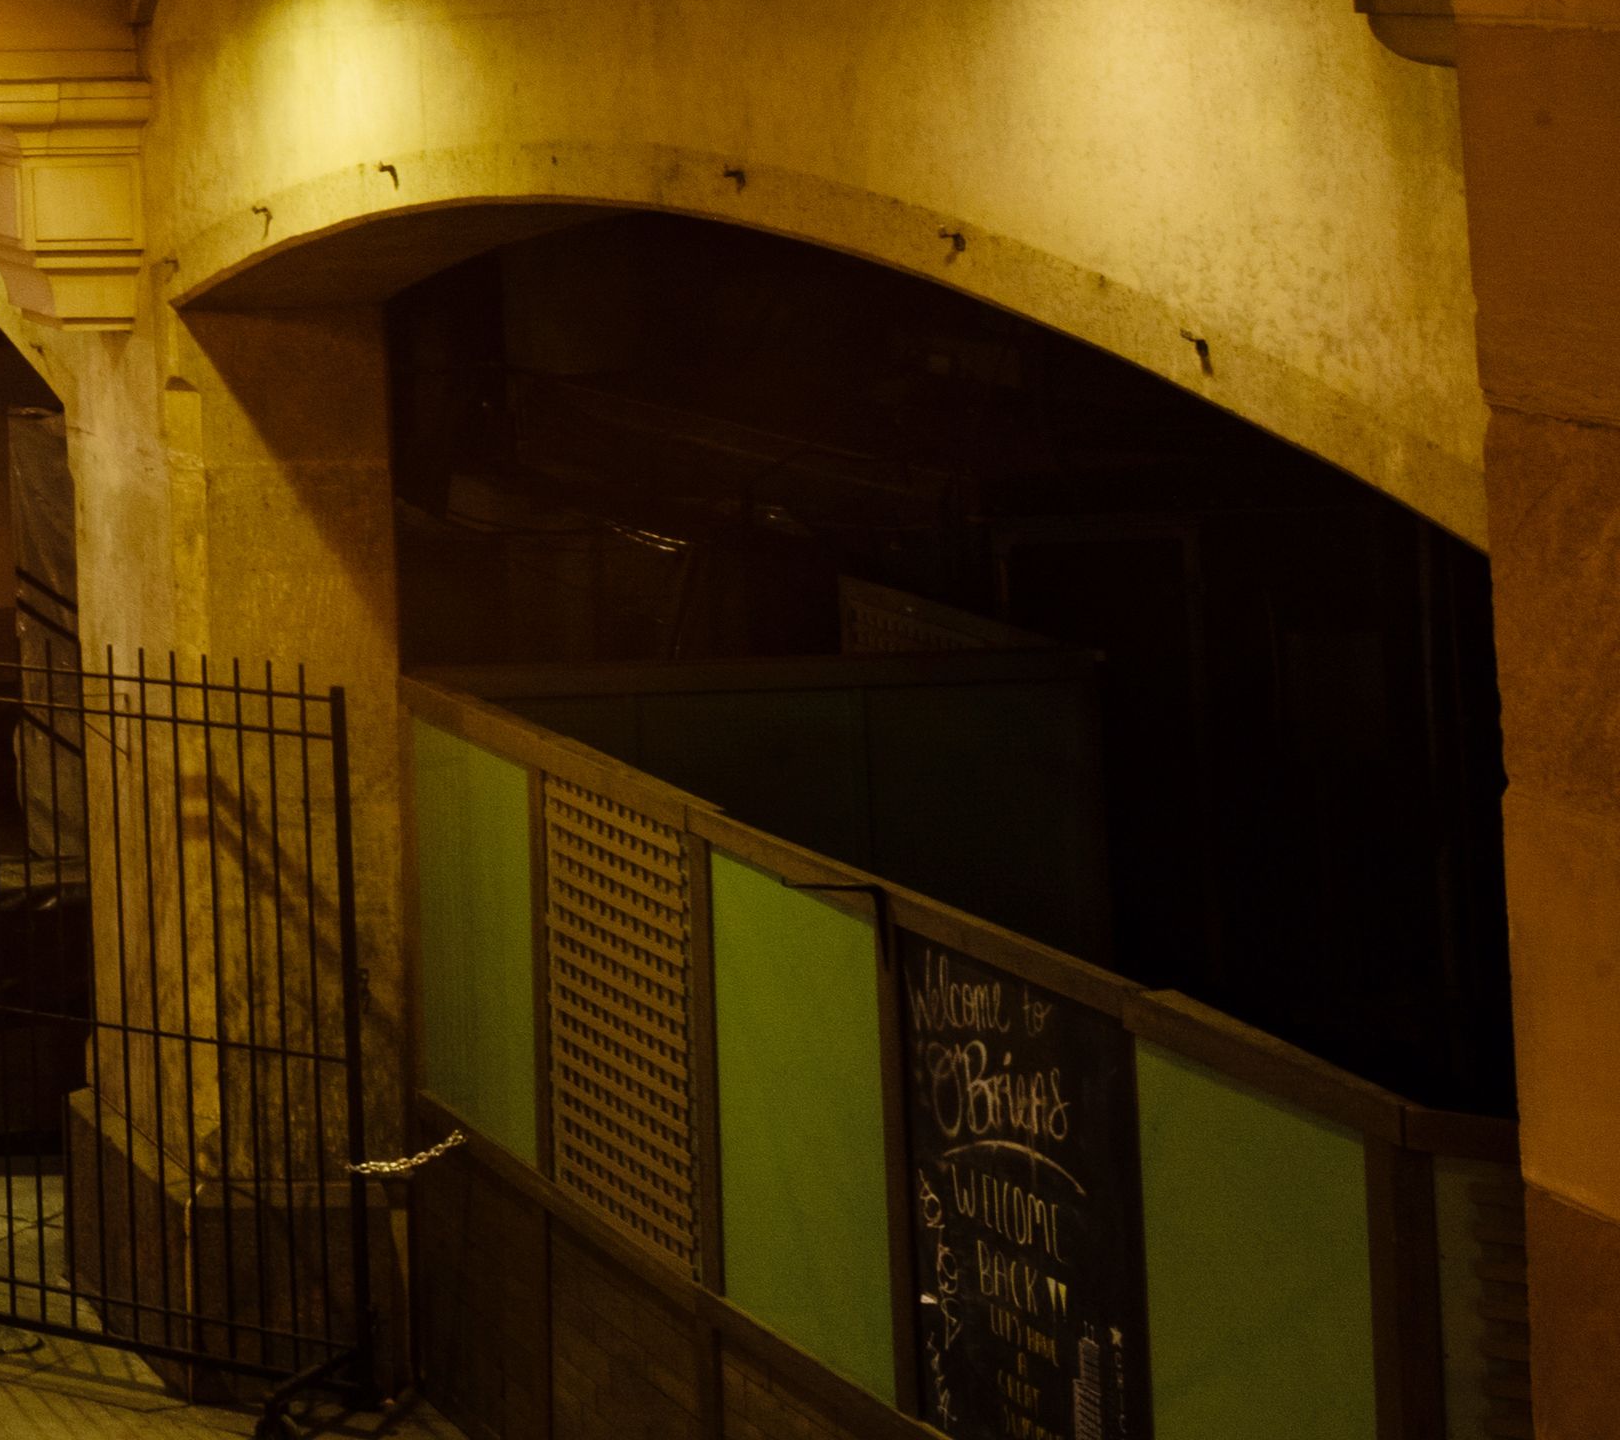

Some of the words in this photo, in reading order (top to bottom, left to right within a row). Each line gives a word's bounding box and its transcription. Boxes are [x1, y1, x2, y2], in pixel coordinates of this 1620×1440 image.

[904, 947, 1010, 1033] Welcome
[1022, 987, 1054, 1037] to
[950, 1163, 1068, 1264] WELCOME
